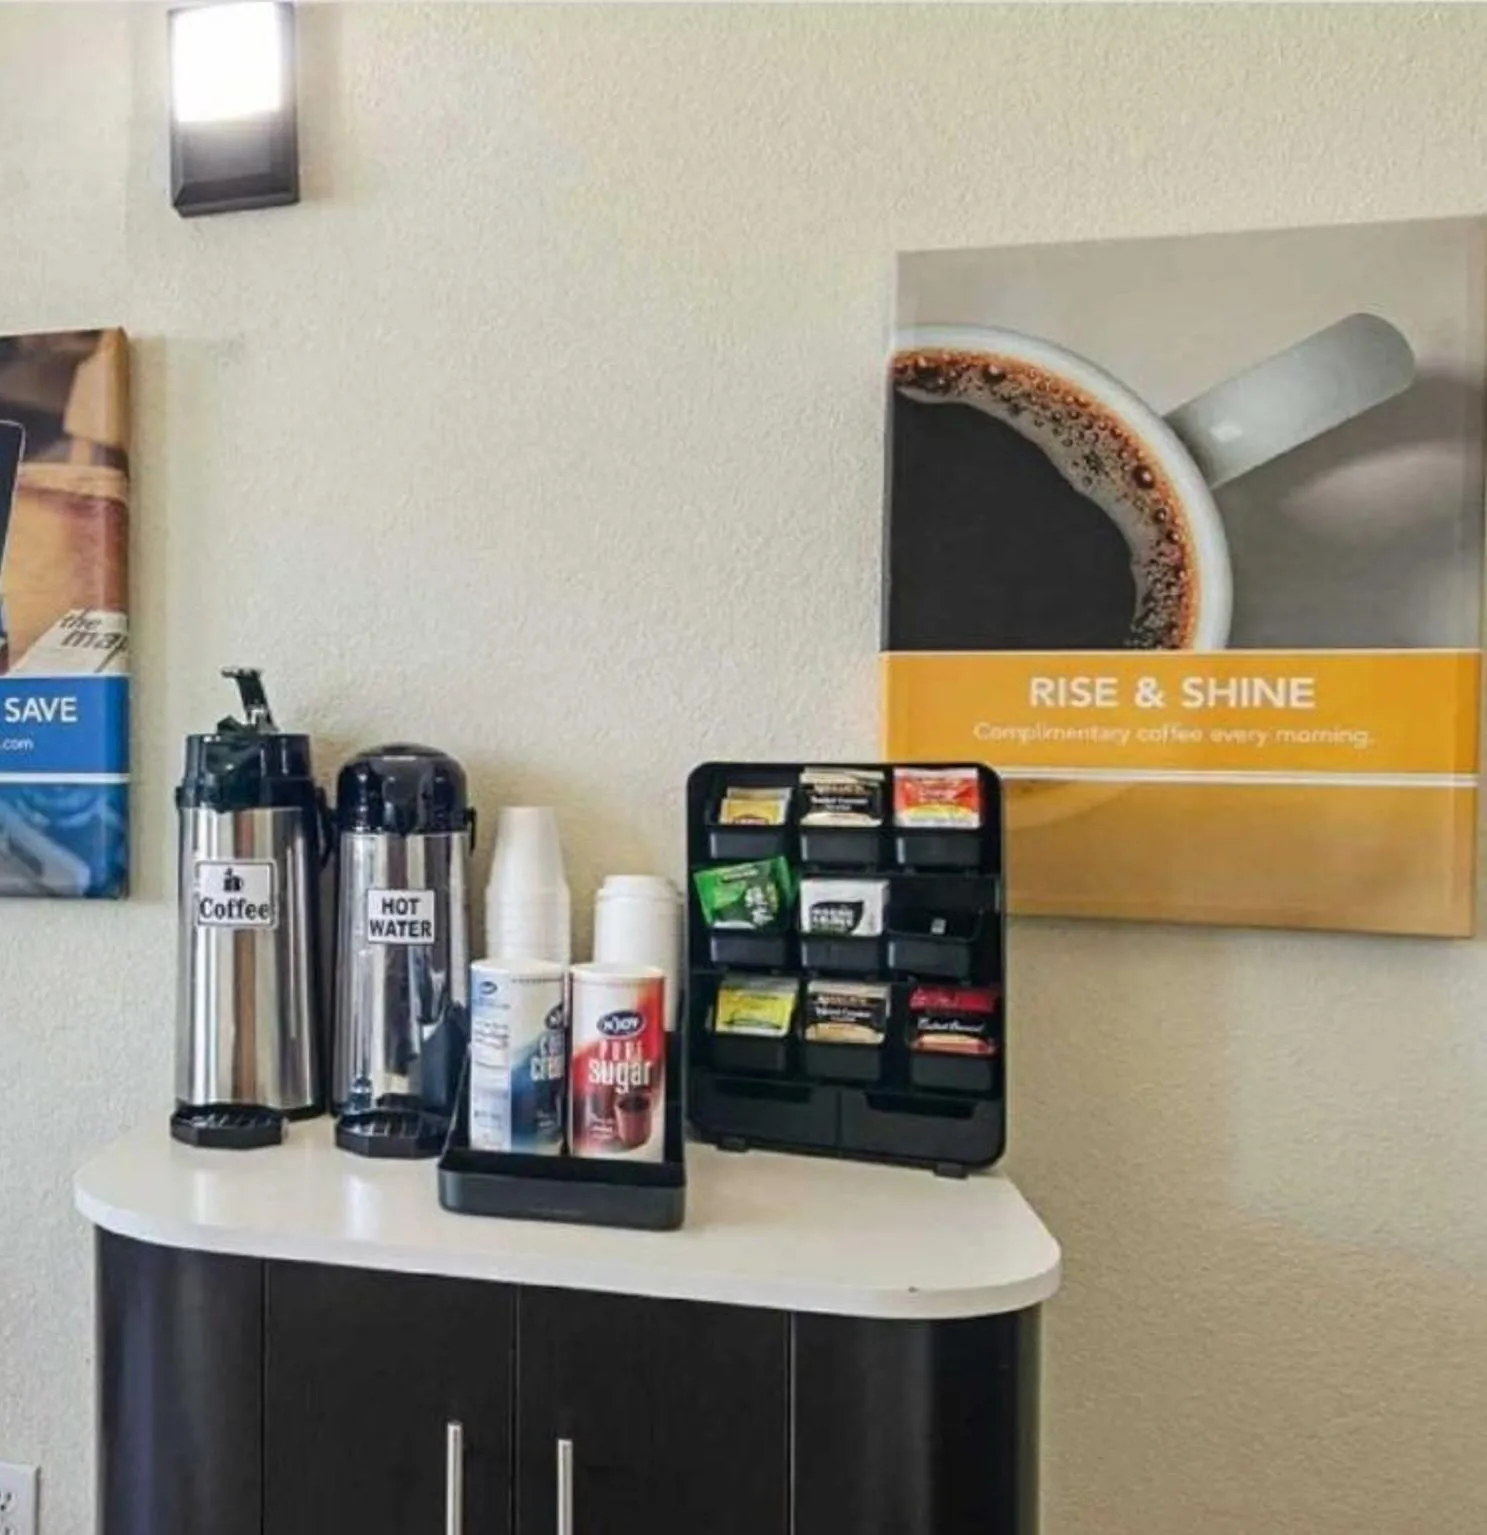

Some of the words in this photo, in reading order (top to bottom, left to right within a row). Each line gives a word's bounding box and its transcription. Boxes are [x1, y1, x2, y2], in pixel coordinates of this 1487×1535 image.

[59, 604, 102, 630] the
[1029, 677, 1119, 709] RISE
[1134, 677, 1166, 709] &
[1180, 677, 1316, 709] SHINE
[4, 696, 79, 723] SAVE
[973, 721, 1130, 746] Complimentary
[1136, 722, 1203, 743] coffee
[1210, 727, 1269, 749] every
[1276, 726, 1374, 750] morning.
[199, 897, 270, 922] Coffee
[381, 897, 421, 916] HOT
[369, 919, 433, 938] WATER
[588, 1057, 654, 1095] sugar
